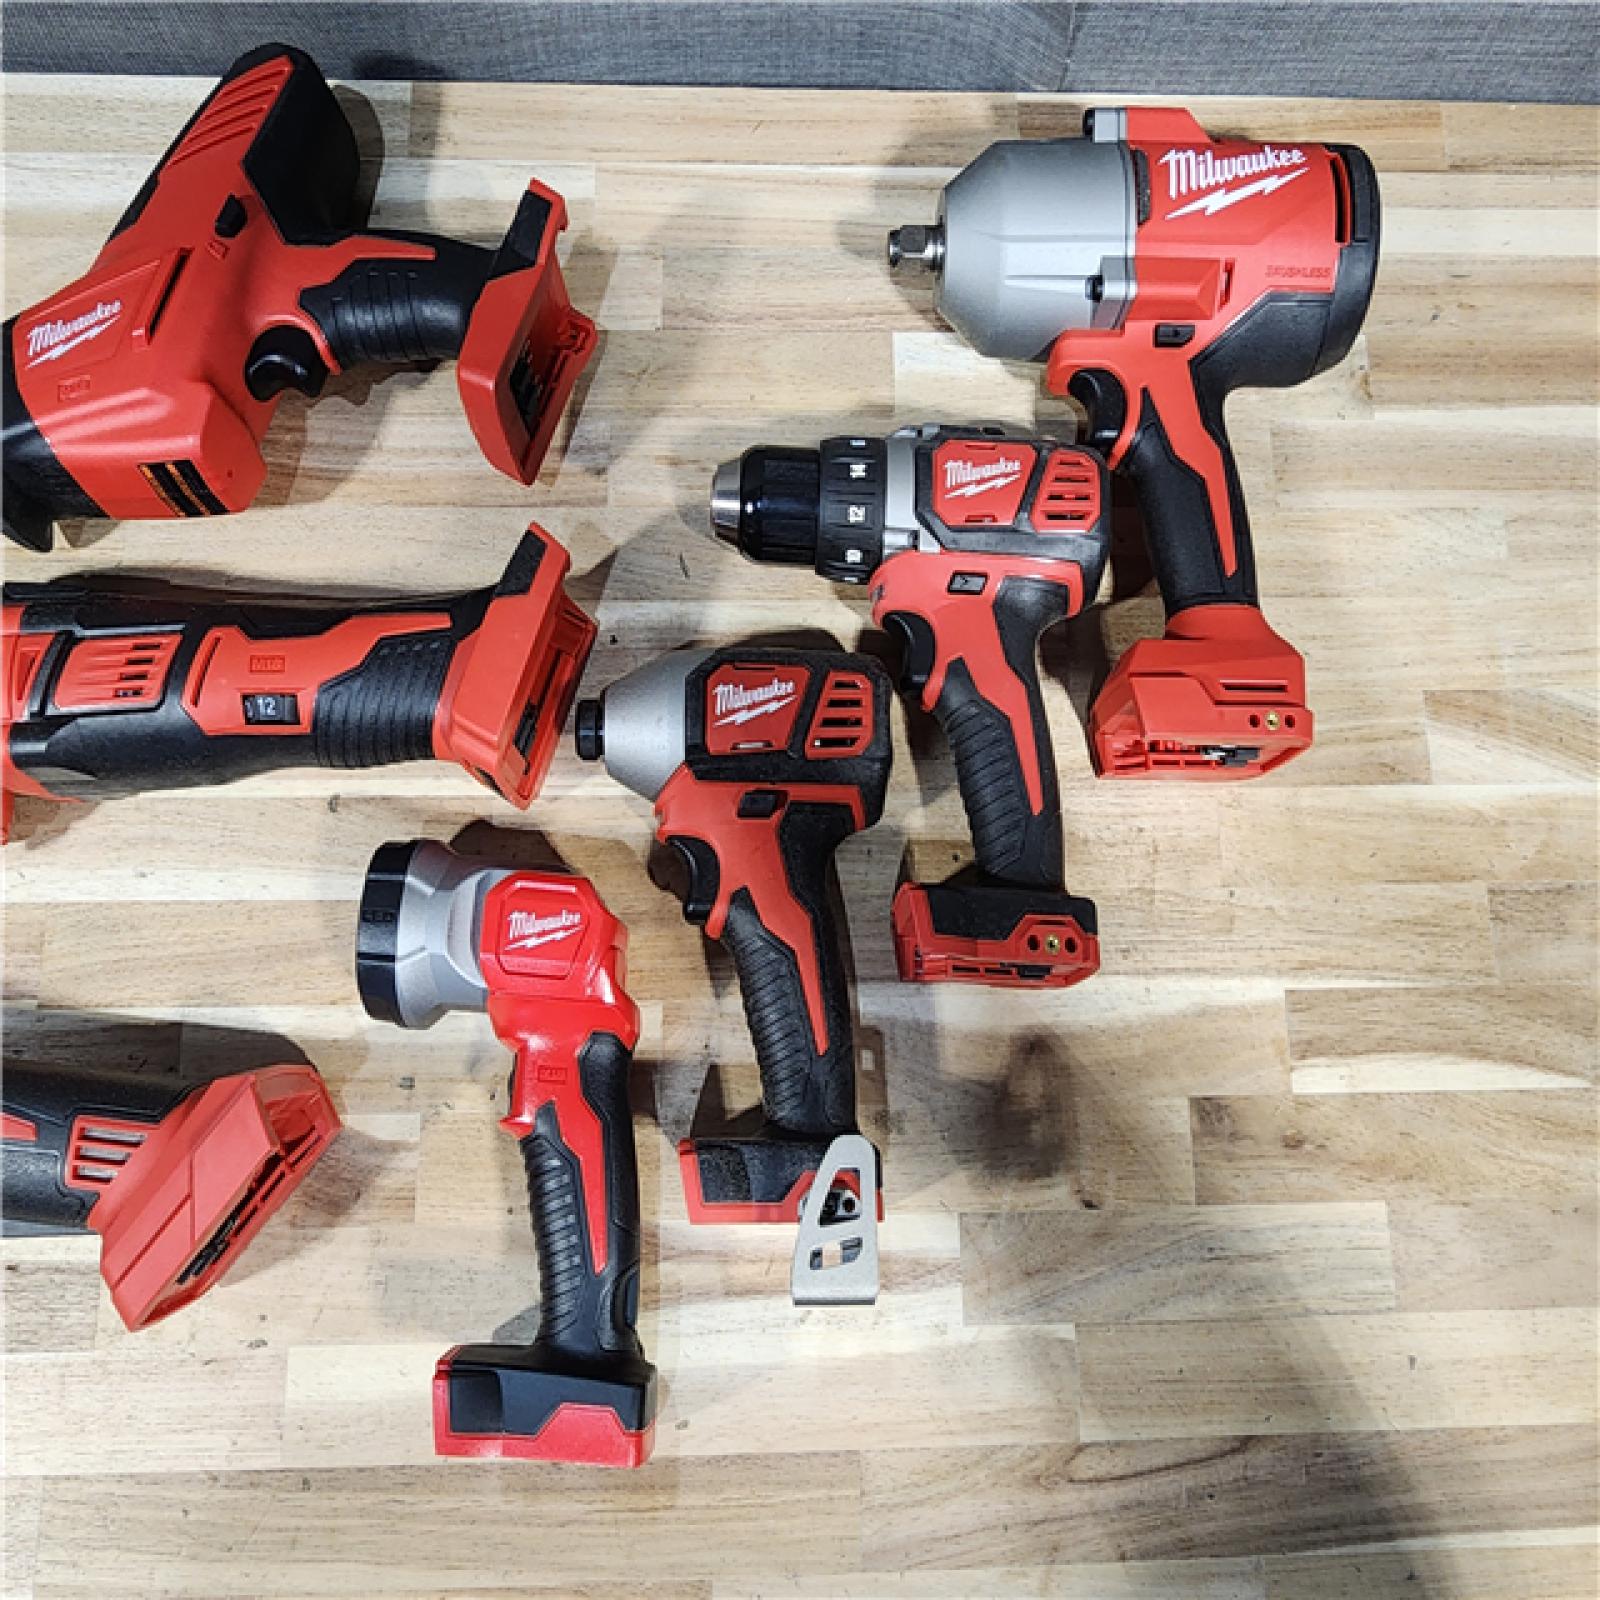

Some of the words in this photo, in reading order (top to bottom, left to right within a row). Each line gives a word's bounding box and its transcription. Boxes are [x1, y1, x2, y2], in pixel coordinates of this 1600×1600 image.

[1158, 145, 1307, 200] Milwaukee
[944, 457, 1021, 488] Milwaukee
[257, 697, 275, 716] 12
[711, 677, 795, 716] Milwaukee
[506, 909, 581, 940] Milwaukee
